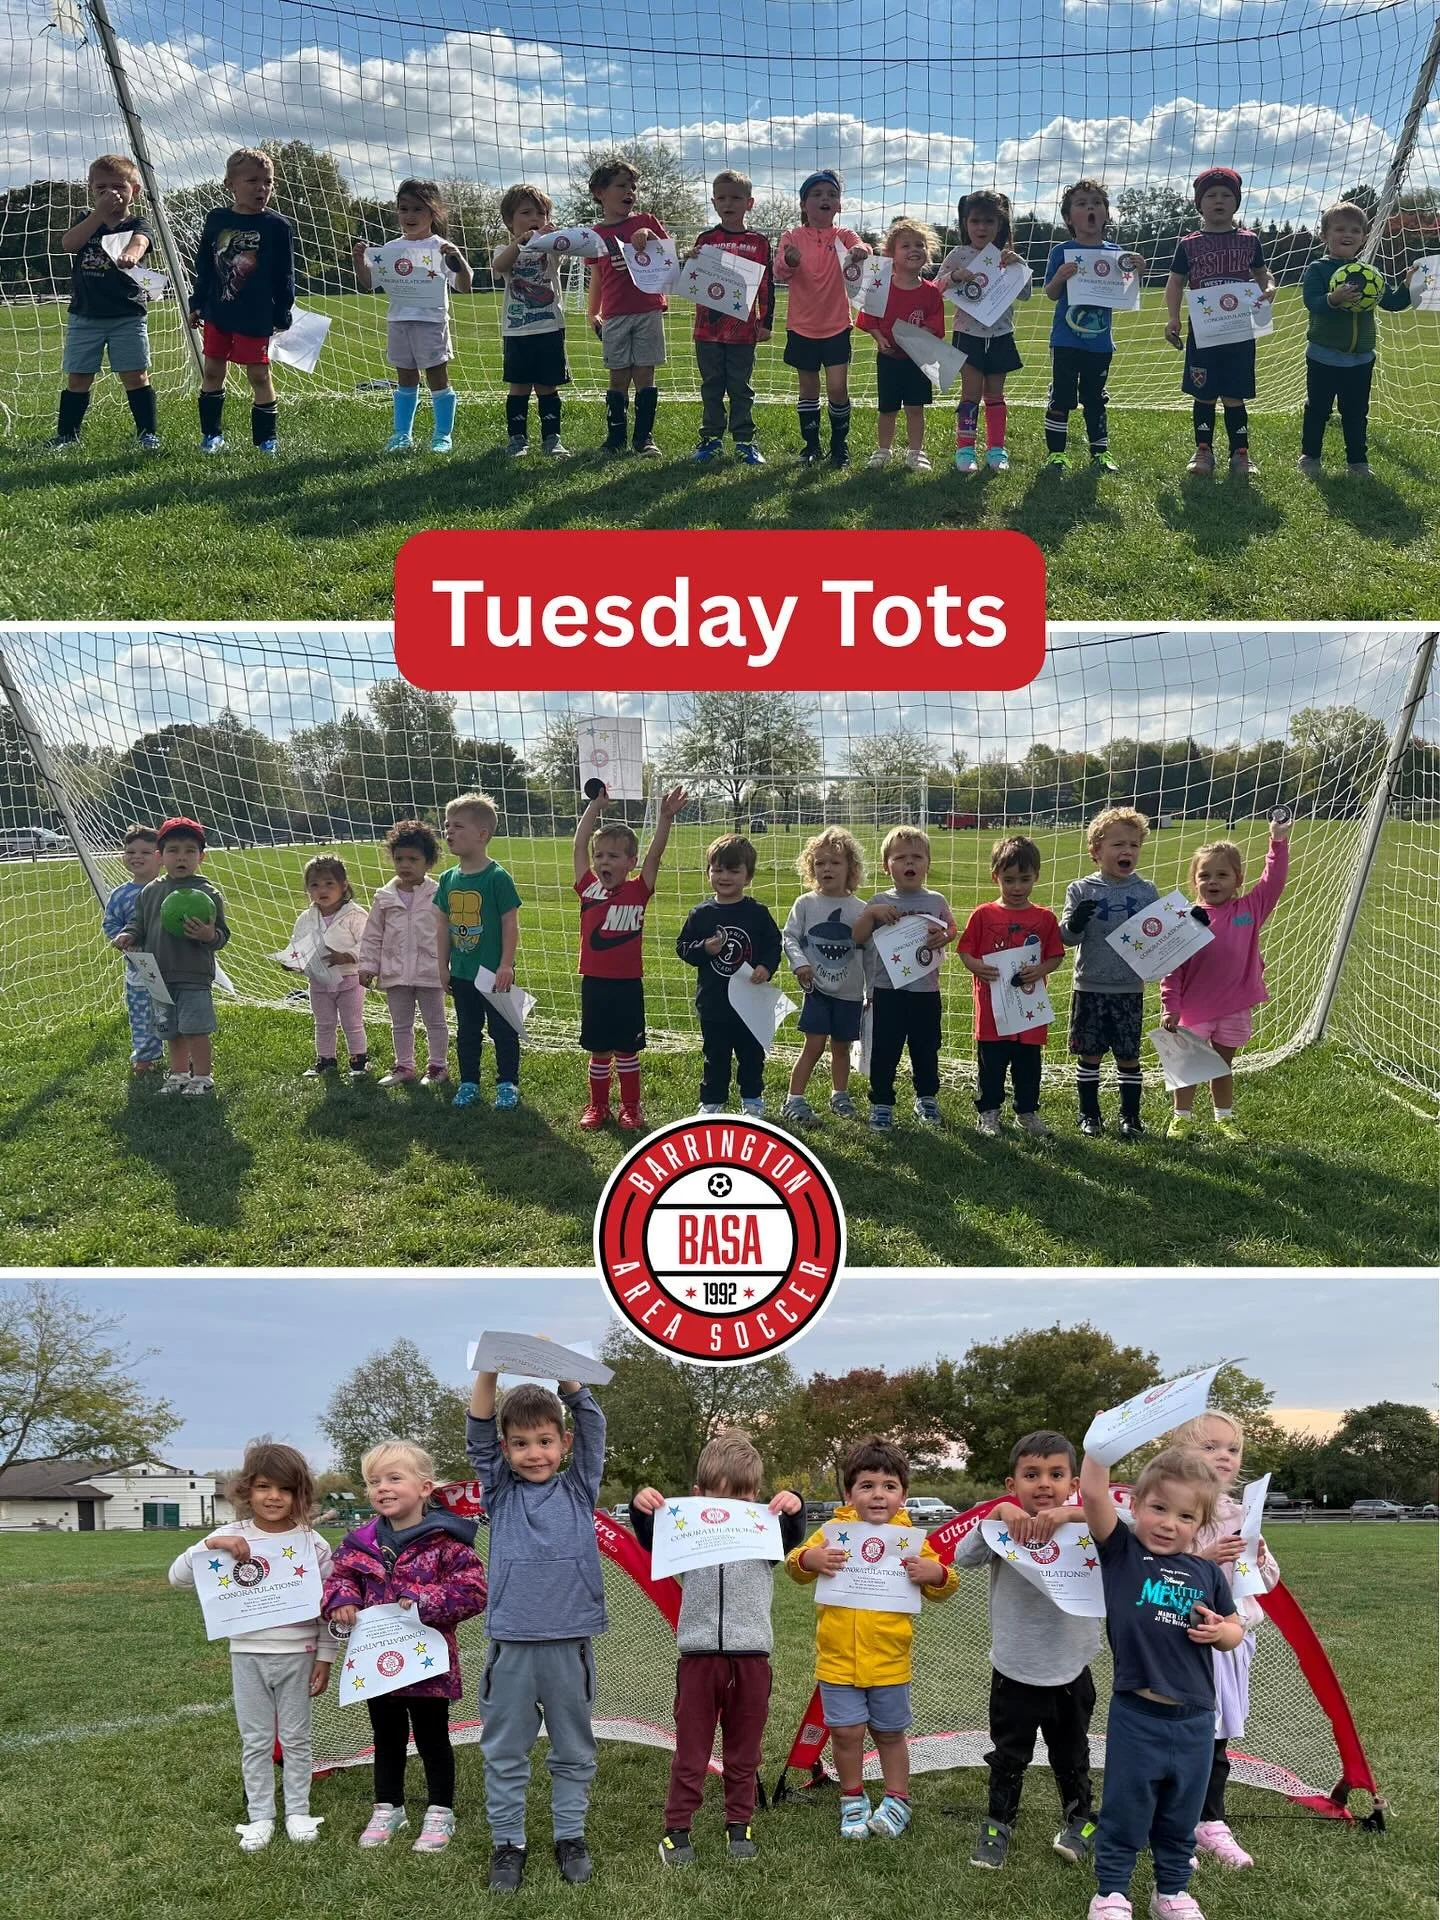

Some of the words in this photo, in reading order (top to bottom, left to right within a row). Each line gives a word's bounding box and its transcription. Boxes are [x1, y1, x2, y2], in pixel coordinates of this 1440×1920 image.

[601, 905, 645, 931] NIKE
[594, 1515, 617, 1541] tra
[938, 1514, 980, 1544] Ultra
